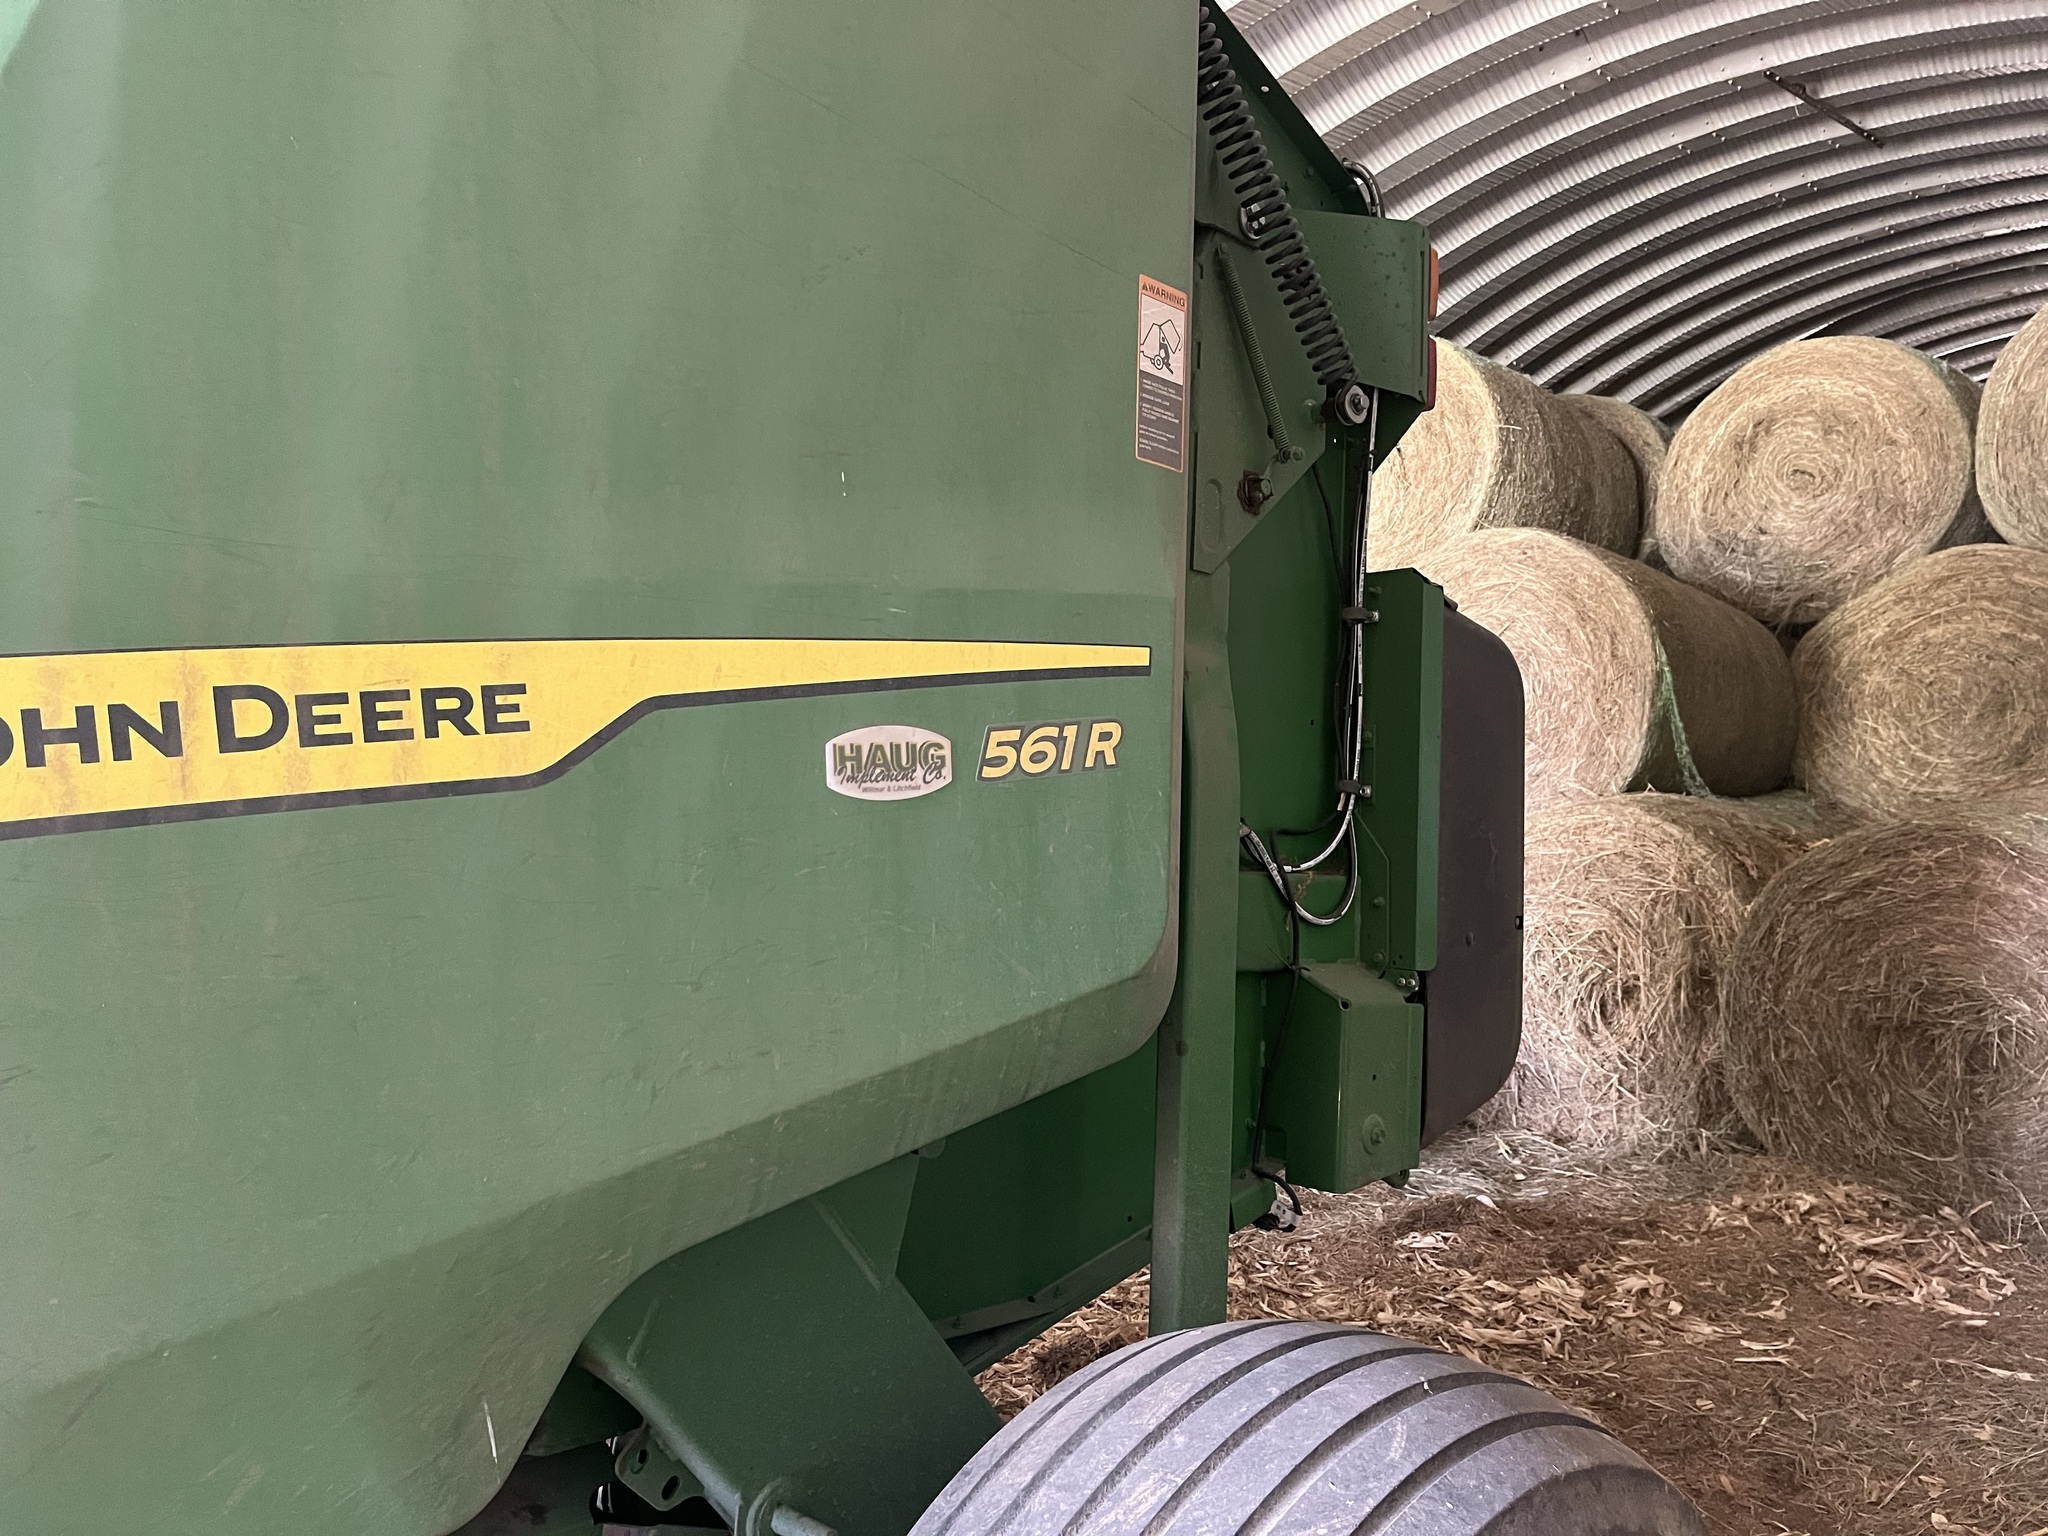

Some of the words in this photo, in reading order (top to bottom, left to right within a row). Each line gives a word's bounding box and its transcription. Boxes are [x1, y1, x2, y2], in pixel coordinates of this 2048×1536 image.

[1147, 282, 1185, 307] WARNING
[0, 700, 184, 769] HN
[212, 683, 531, 754] DEERE
[832, 739, 947, 776] HAUG
[835, 764, 918, 789] Implement
[922, 761, 947, 785] Co.
[892, 784, 922, 793] Litchfield
